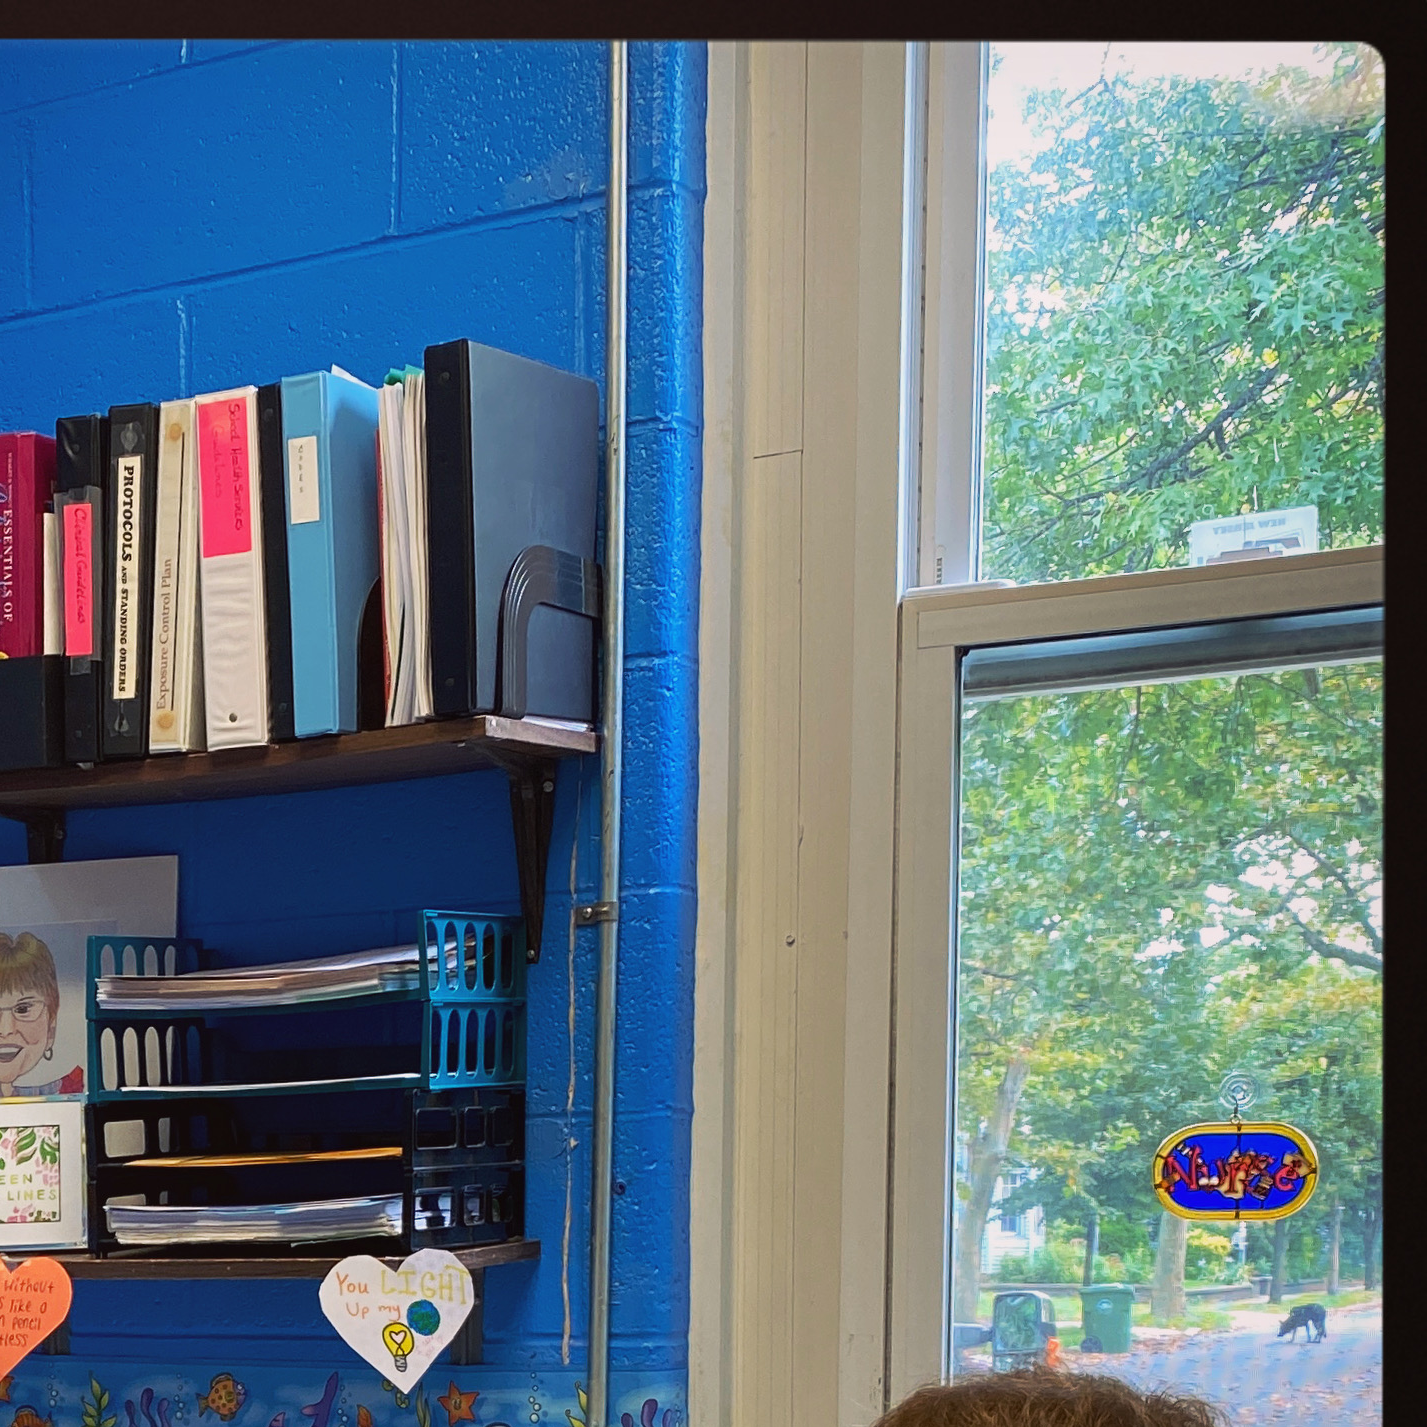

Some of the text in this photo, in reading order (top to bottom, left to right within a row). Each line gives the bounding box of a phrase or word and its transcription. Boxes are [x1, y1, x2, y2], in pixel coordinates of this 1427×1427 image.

[228, 403, 241, 442] School
[2, 509, 14, 622] ESSENTIALS OF
[117, 464, 135, 693] PROTOCOLS AND STANDING ORDERS
[155, 558, 173, 710] Exposure Control Plan
[7, 1189, 58, 1202] LINES
[335, 1264, 470, 1305] You LIGHT
[9, 1299, 32, 1314] like
[346, 1302, 402, 1323] Up my
